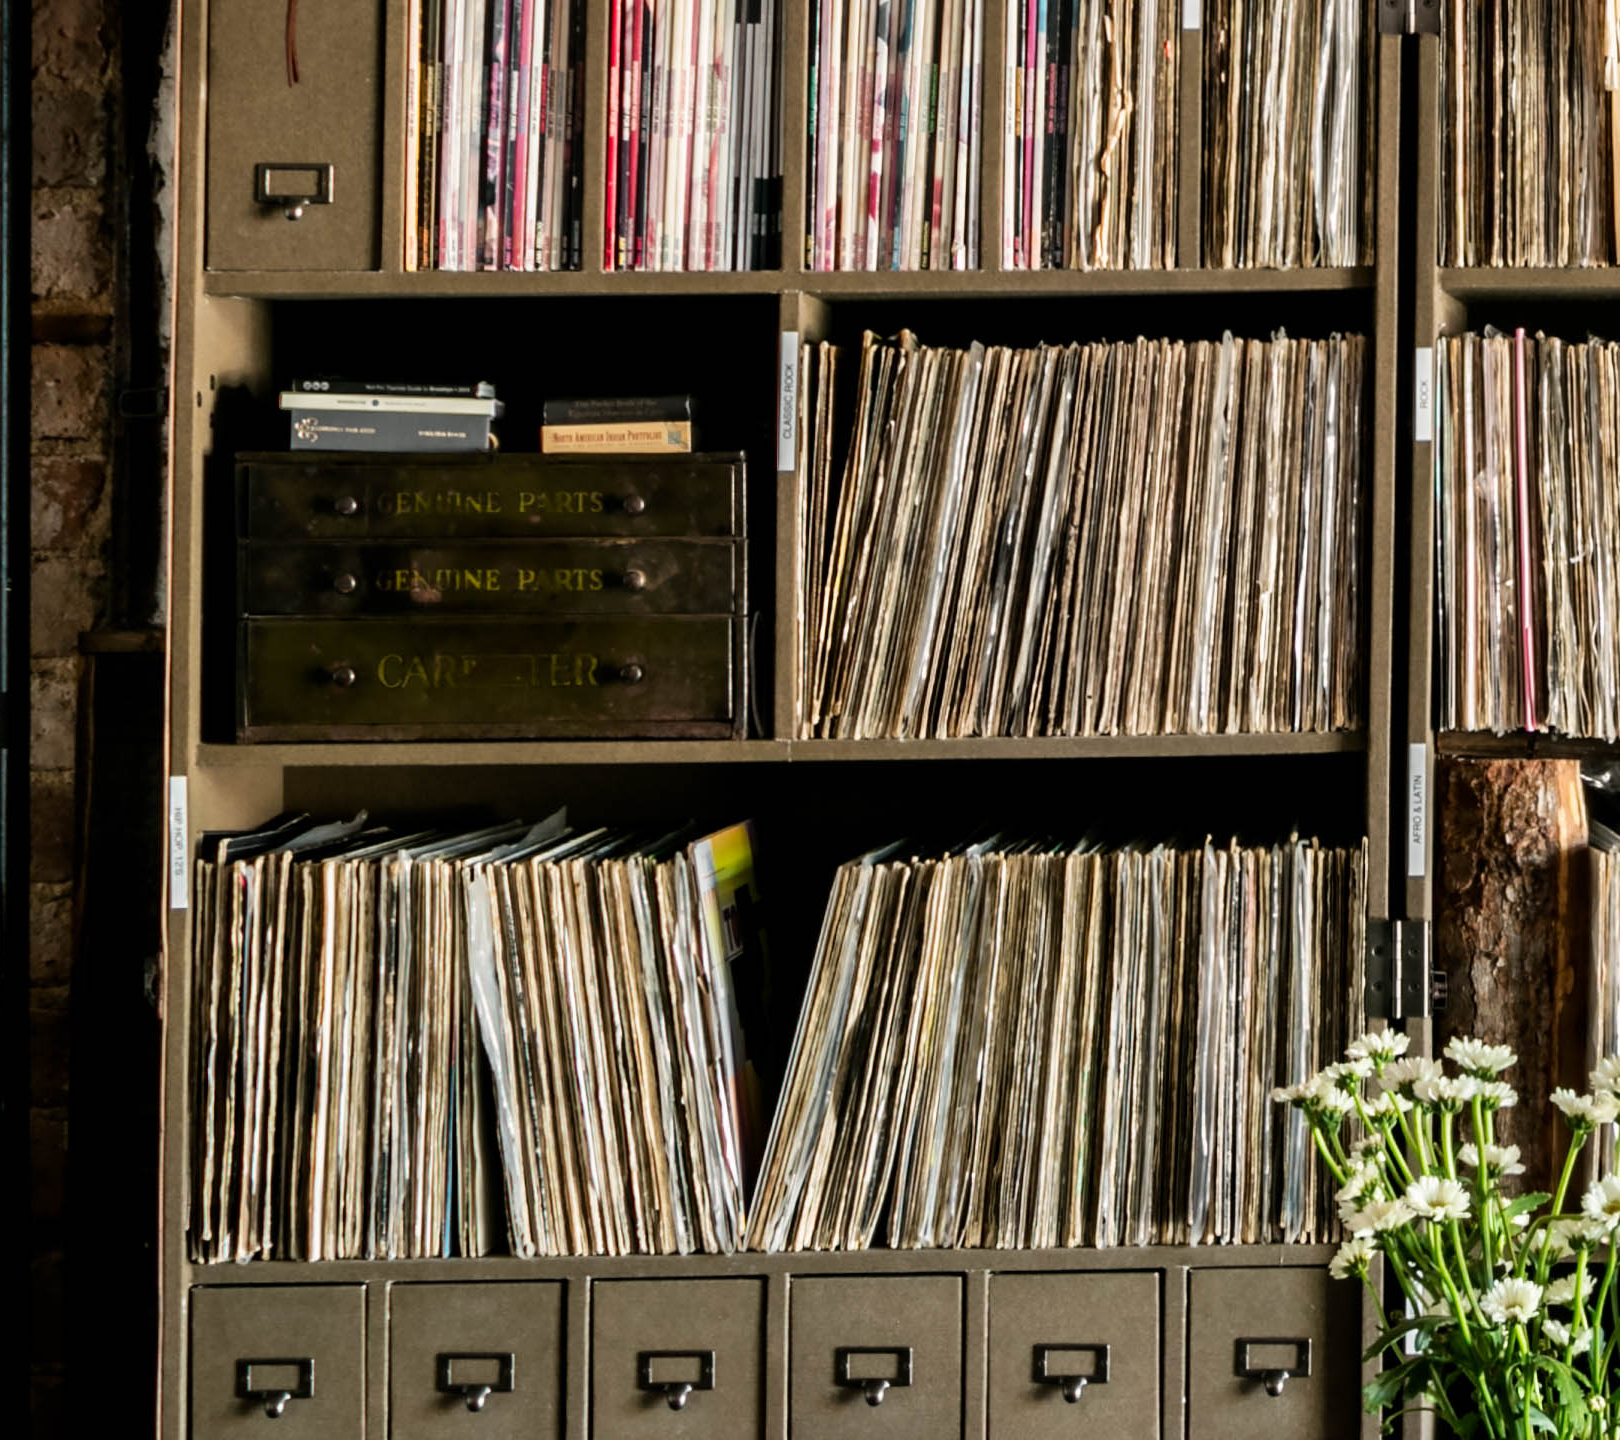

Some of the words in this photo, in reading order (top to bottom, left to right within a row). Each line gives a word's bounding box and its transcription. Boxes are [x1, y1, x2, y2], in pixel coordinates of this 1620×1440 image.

[783, 363, 794, 393] ROCK
[1420, 379, 1429, 409] ROCK
[782, 395, 793, 440] CLASSIC
[1413, 775, 1422, 804] LATIN
[1413, 816, 1422, 844] AFRO
